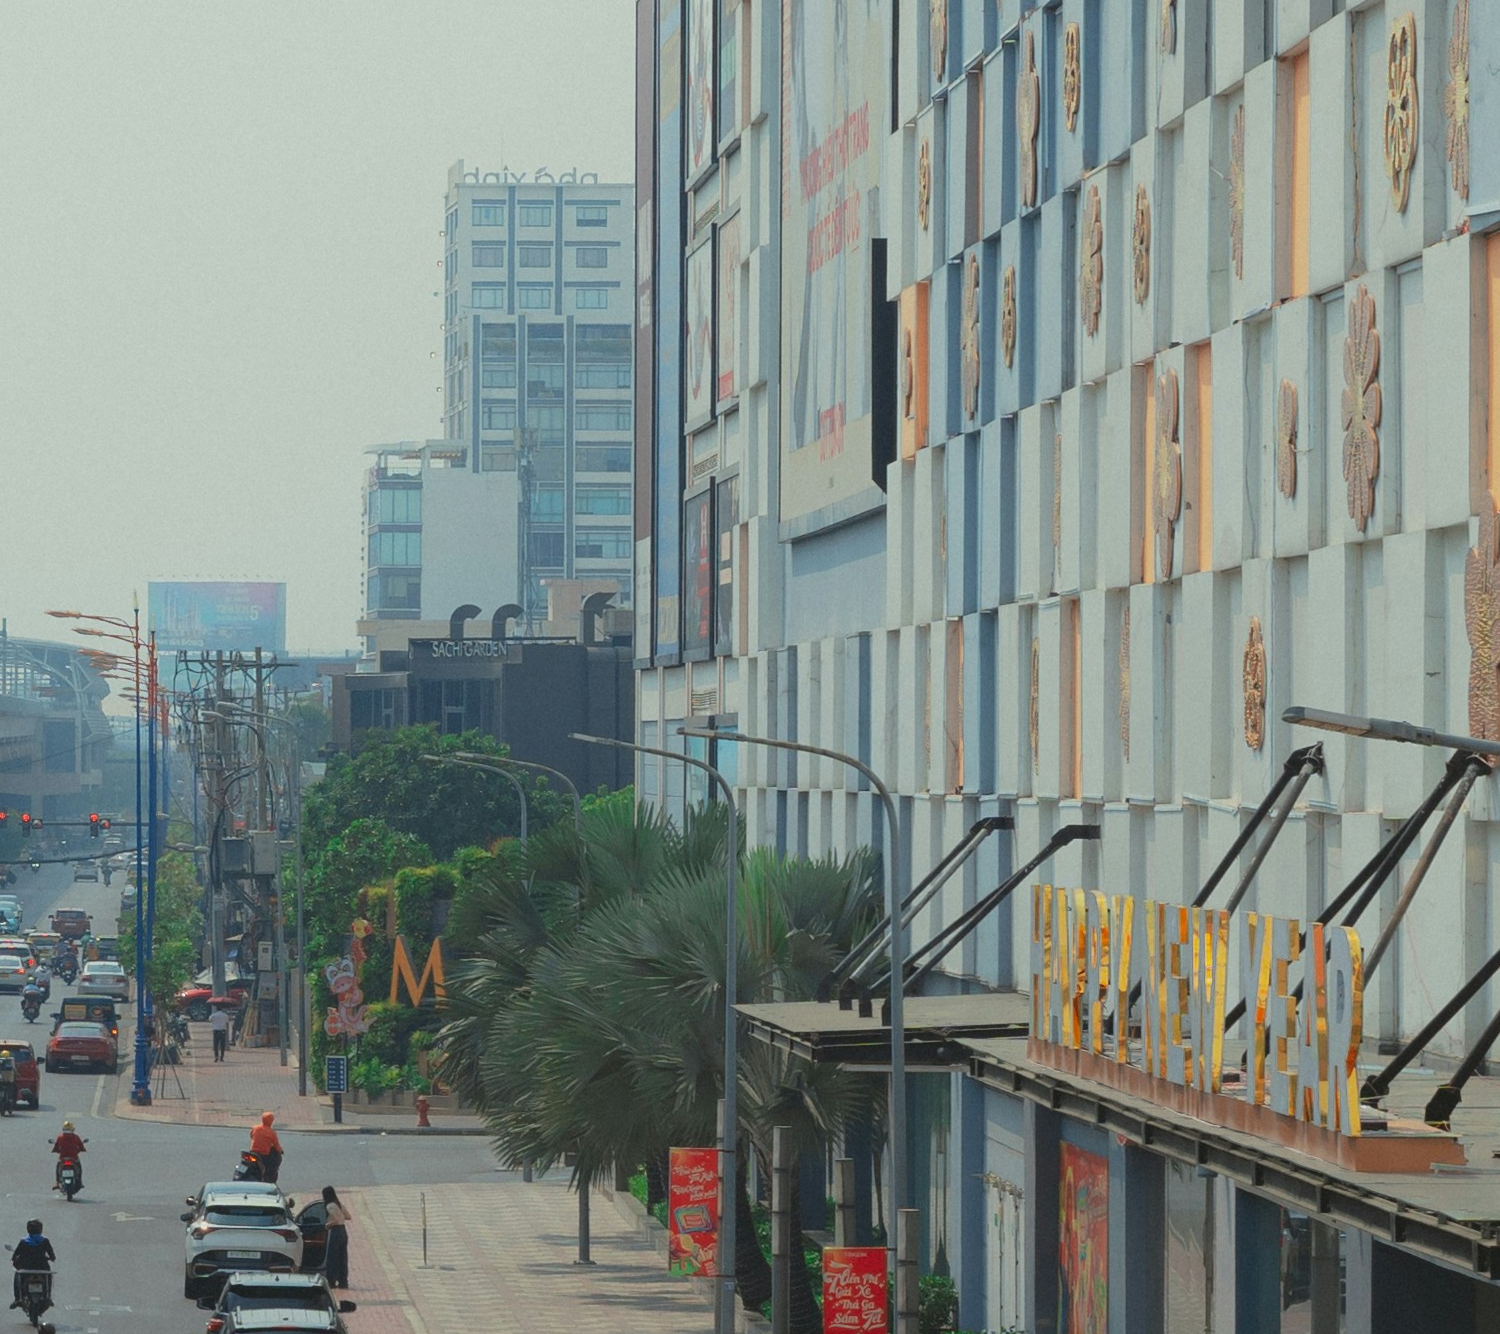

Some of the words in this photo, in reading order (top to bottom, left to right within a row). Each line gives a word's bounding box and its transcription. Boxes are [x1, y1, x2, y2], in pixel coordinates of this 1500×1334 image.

[431, 641, 462, 658] SACHI
[463, 641, 507, 657] GARDEN
[1028, 884, 1134, 1064] HAPPY
[1141, 899, 1231, 1094] NEW
[1242, 910, 1364, 1137] YEAR
